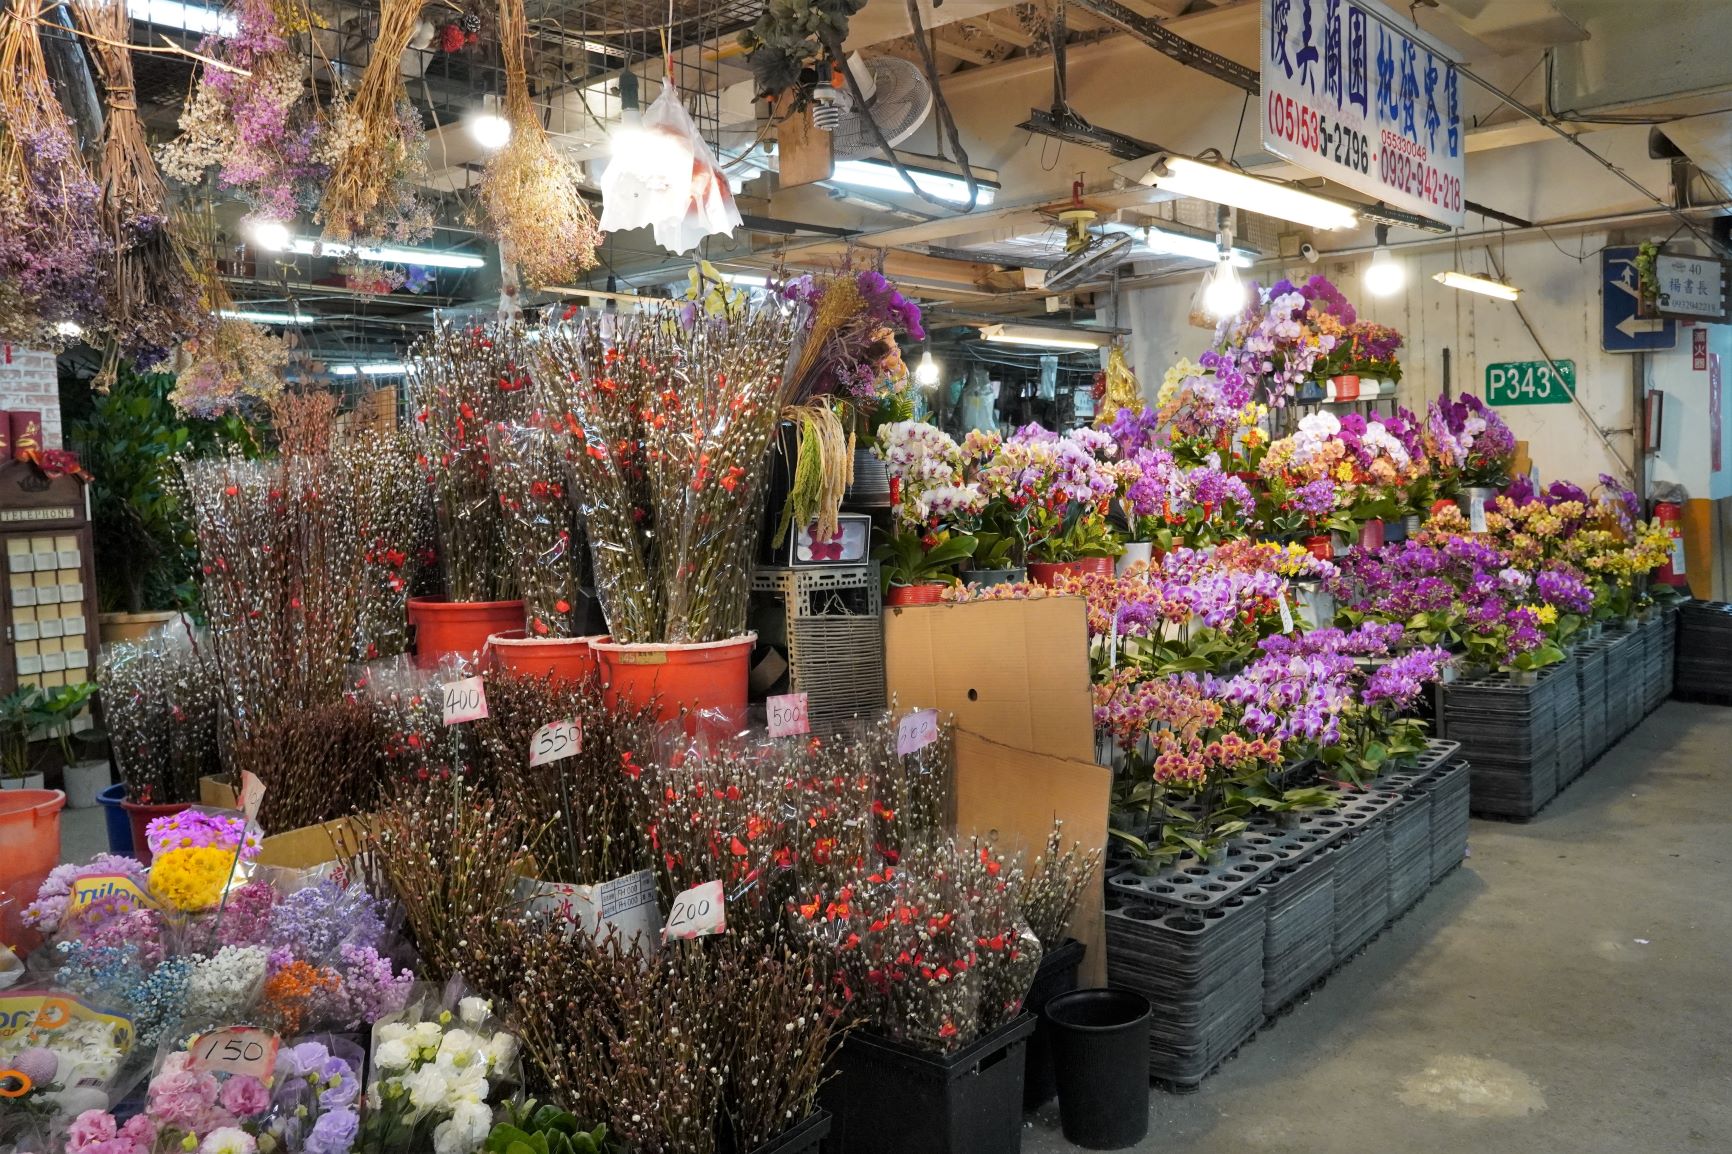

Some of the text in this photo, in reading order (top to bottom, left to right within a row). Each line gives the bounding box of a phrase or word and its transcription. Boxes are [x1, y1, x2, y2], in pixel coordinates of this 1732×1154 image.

[1268, 90, 1369, 175] (05)535-2796
[1381, 129, 1427, 162] 055330048
[1381, 147, 1461, 213] 0932-942-218
[1688, 263, 1702, 275] 40
[1669, 278, 1708, 296] 楊書長
[1489, 366, 1551, 400] P343
[5, 509, 71, 521] TELEPHONE
[445, 688, 480, 714] 400
[773, 705, 800, 727] 500
[538, 725, 580, 756] 550
[670, 899, 710, 926] 200
[205, 1039, 264, 1061] 150
